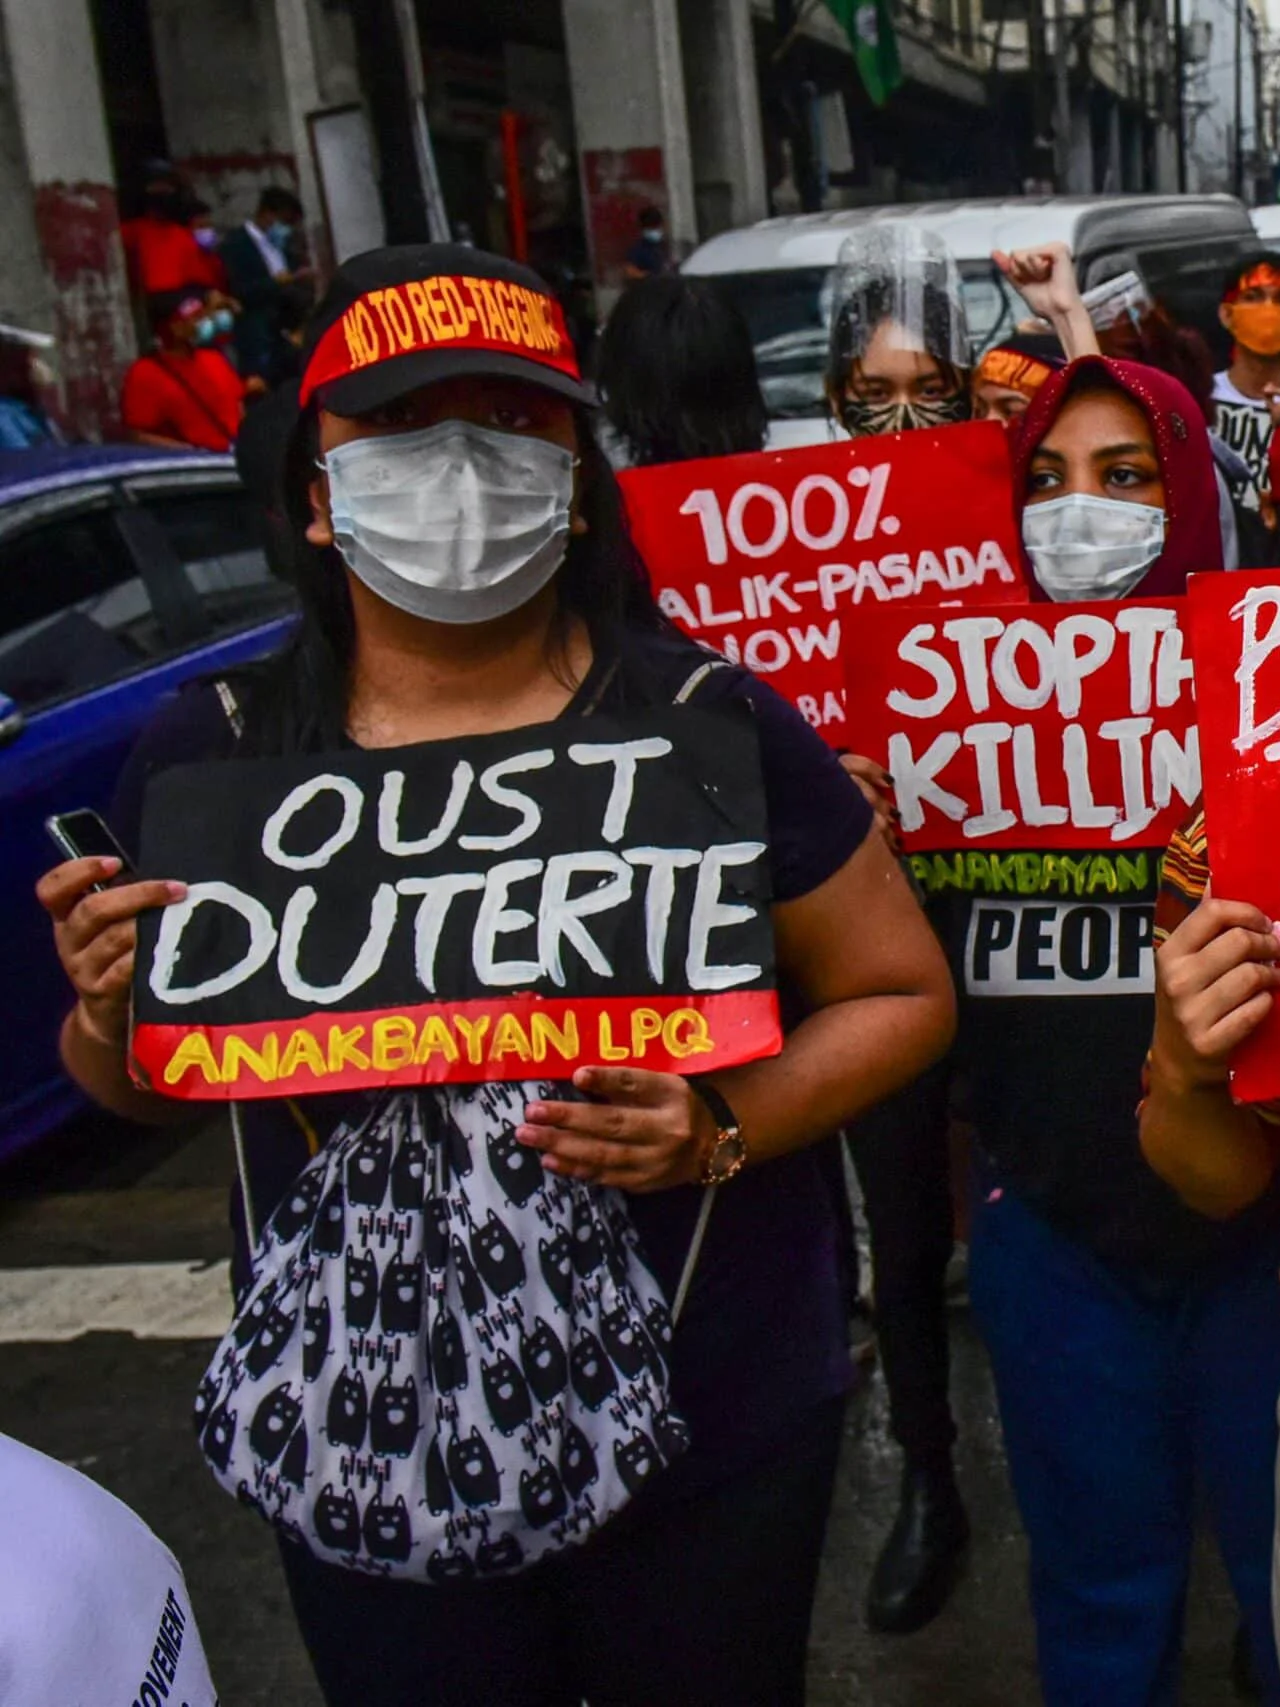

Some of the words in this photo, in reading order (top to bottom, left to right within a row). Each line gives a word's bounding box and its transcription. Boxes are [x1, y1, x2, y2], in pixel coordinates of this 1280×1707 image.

[343, 300, 379, 370] NO
[367, 287, 416, 355] TO
[679, 462, 901, 565] 100%
[886, 614, 1116, 718] STOP
[262, 736, 673, 871] OUST
[149, 841, 768, 1005] DUTERTE
[907, 851, 1149, 896] ANAKBAYAN
[164, 1009, 580, 1085] ANAKBAYAN
[599, 1008, 715, 1061] LPQ
